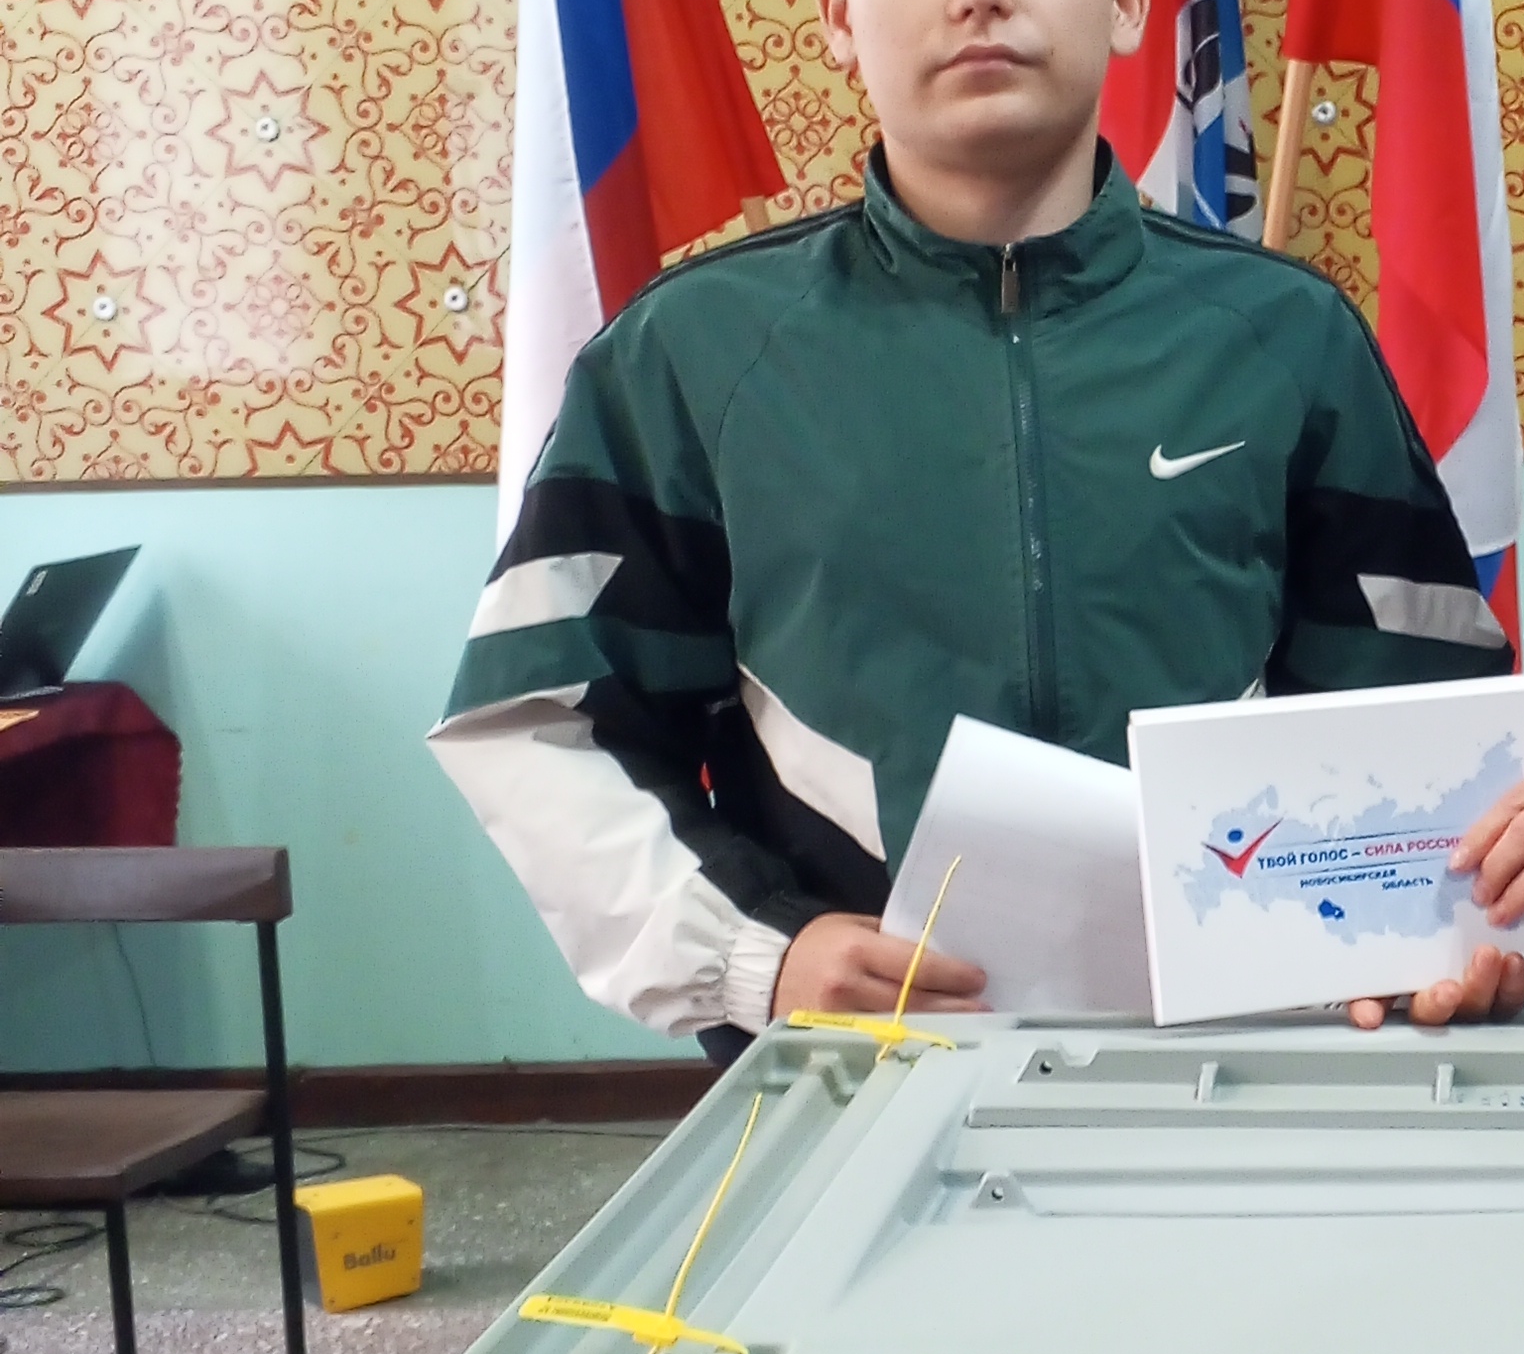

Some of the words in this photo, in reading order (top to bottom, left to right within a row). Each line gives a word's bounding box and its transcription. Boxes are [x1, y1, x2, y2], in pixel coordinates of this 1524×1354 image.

[1257, 852, 1297, 871] ТВОЙ
[1300, 848, 1349, 866] ГОЛОС
[1364, 841, 1404, 857] СИЛА
